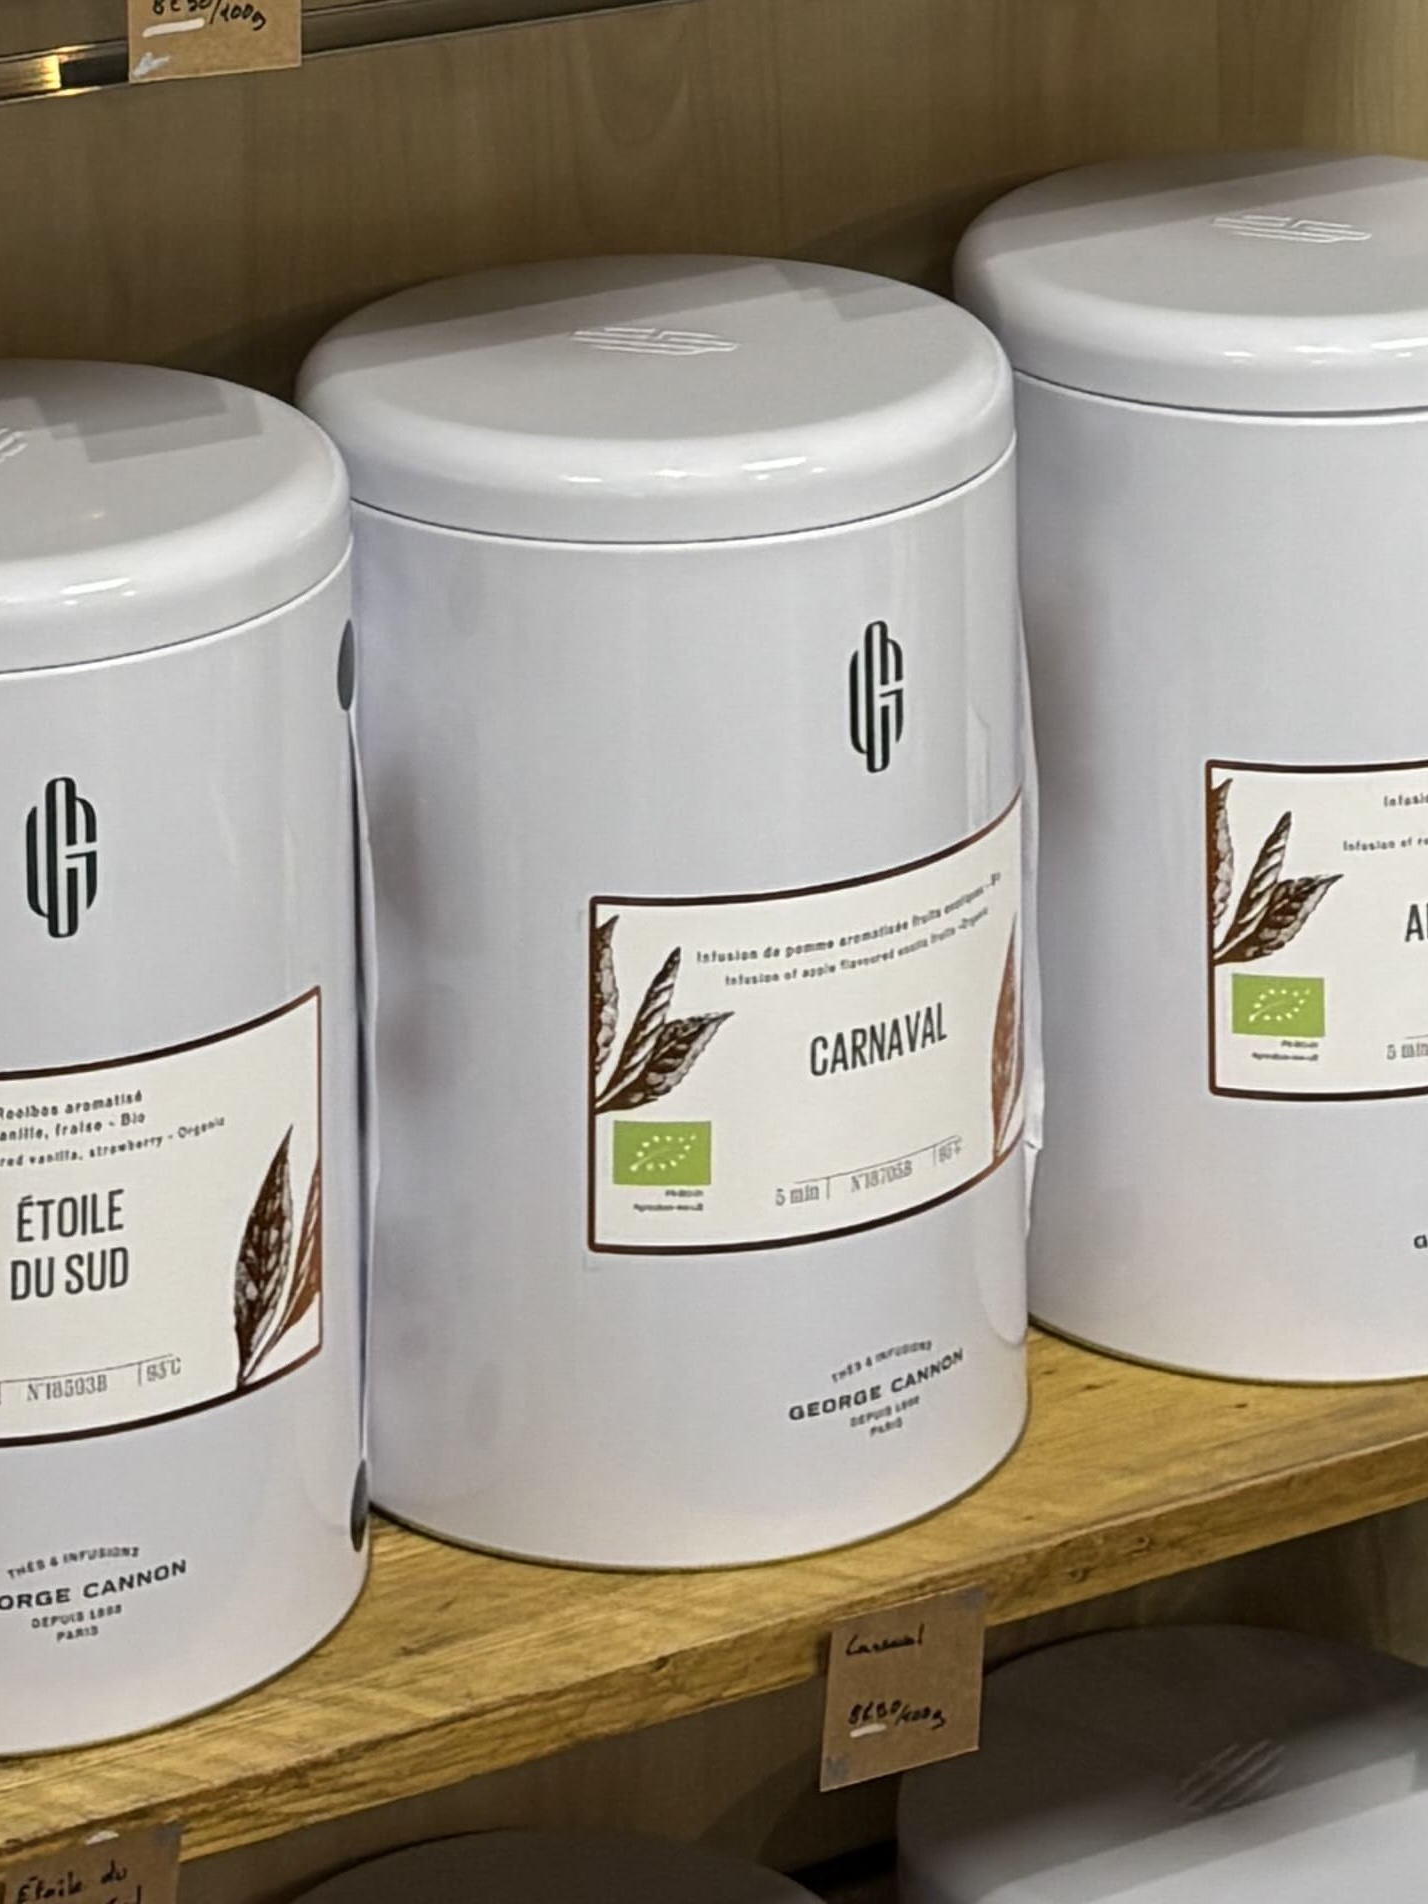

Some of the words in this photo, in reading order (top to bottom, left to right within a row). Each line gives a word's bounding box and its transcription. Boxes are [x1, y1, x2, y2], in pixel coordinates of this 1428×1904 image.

[811, 1003, 947, 1076] CARNAVAL
[121, 1113, 145, 1126] Bio
[17, 1189, 124, 1242] ÉTOILE
[11, 1257, 54, 1300] DU
[65, 1247, 128, 1294] SUD
[789, 1385, 888, 1421] GEORGE
[891, 1349, 963, 1392] CANNON
[83, 1560, 186, 1598] CANNON
